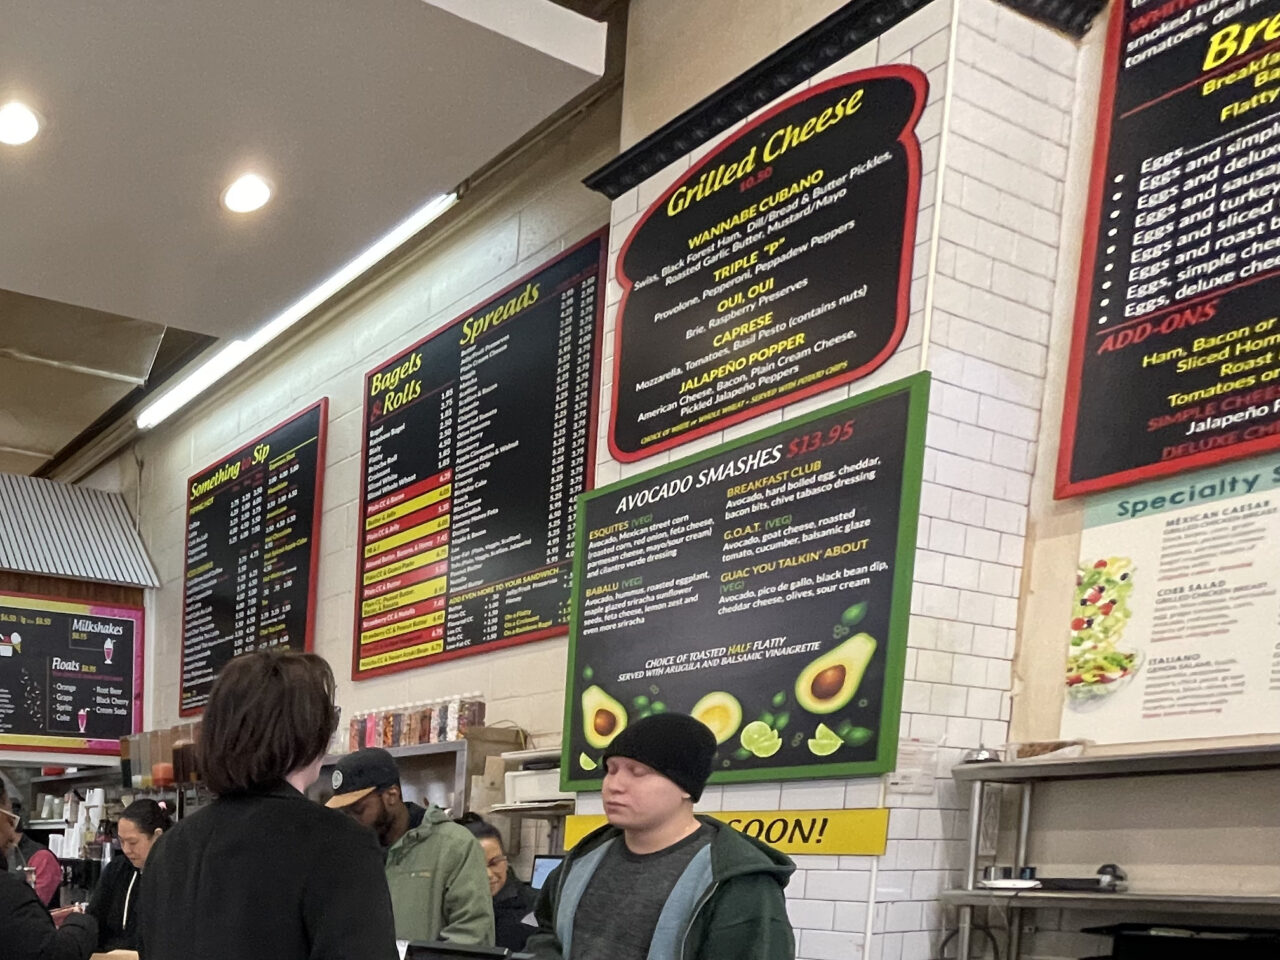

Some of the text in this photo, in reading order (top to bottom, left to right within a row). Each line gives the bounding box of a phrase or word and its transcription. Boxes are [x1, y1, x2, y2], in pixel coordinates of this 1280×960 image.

[1212, 0, 1246, 25] deli
[667, 88, 864, 216] Grilled Cheese
[1140, 147, 1183, 174] Eggs
[661, 258, 685, 278] Black
[686, 243, 715, 264] Forest
[746, 198, 799, 233] Dill/Bread
[800, 193, 810, 205] &
[812, 174, 848, 199] Butter
[688, 169, 824, 249] WANNABE CUBANO
[665, 260, 702, 286] Roasted
[702, 248, 730, 267] Garlic
[767, 188, 847, 234] Mustard/Mayo
[754, 242, 809, 275] Peppadew
[810, 220, 855, 248] Peppers
[1130, 198, 1274, 264] Eggs and sliced
[713, 250, 759, 282] TRIPLE
[1177, 252, 1237, 282] simple
[708, 302, 757, 329] Raspberry
[758, 278, 808, 307] Preserves
[747, 277, 774, 299] OUI
[1175, 271, 1236, 300] deluxe
[459, 283, 539, 345] Spreads
[713, 312, 773, 347] CAPRESE
[732, 332, 757, 352] Basil
[757, 322, 787, 341] Pesto
[788, 300, 837, 328] (contains
[838, 284, 868, 305] nuts)
[1097, 300, 1218, 356] ADD-ONS
[1192, 326, 1250, 352] Bacon
[1254, 317, 1278, 333] or
[371, 353, 422, 396] Bagels
[679, 333, 805, 394] JALAPEÑO POPPER
[1176, 346, 1230, 373] Sliced
[1220, 352, 1274, 377] Roast
[383, 380, 422, 415] Rolls
[637, 401, 678, 422] American
[750, 362, 776, 378] Plain
[777, 347, 812, 367] Cream
[680, 364, 800, 417] Pickled Jalapeño Peppers
[1168, 375, 1256, 407] Tomatoes
[1186, 405, 1269, 435] Jalapeño
[190, 461, 241, 500] Something
[251, 443, 270, 465] Sip
[616, 419, 855, 514] AVOCADO SMASHES $13.95
[727, 460, 822, 498] BREAKFAST CLUB
[724, 507, 751, 521] bacon
[770, 494, 795, 507] chive
[796, 483, 833, 500] tabasco
[833, 470, 876, 489] dressing
[765, 483, 787, 498] hard
[787, 474, 817, 491] boiled
[1118, 474, 1260, 517] Specialty
[589, 520, 629, 540] ESQUITES
[761, 529, 782, 543] goat
[818, 508, 856, 527] roasted
[801, 524, 843, 542] balsamic
[844, 518, 871, 534] glaze
[720, 538, 869, 583] GUAC YOU TALKIN' ABOUT
[585, 582, 619, 598] BABALU
[717, 602, 752, 616] cheddar
[816, 584, 838, 595] sour
[838, 577, 871, 590] cream
[757, 586, 777, 598] pico
[777, 582, 789, 592] de
[816, 570, 842, 584] black
[843, 565, 868, 578] bean
[72, 619, 123, 635] Milkshakes
[52, 657, 80, 671] Floats
[617, 641, 821, 682] SERVED WITH ARUGULA AND BALSAMIC VINAIGRETTE
[645, 636, 787, 669] CHOICE OF TOASTED HALF FLATTY
